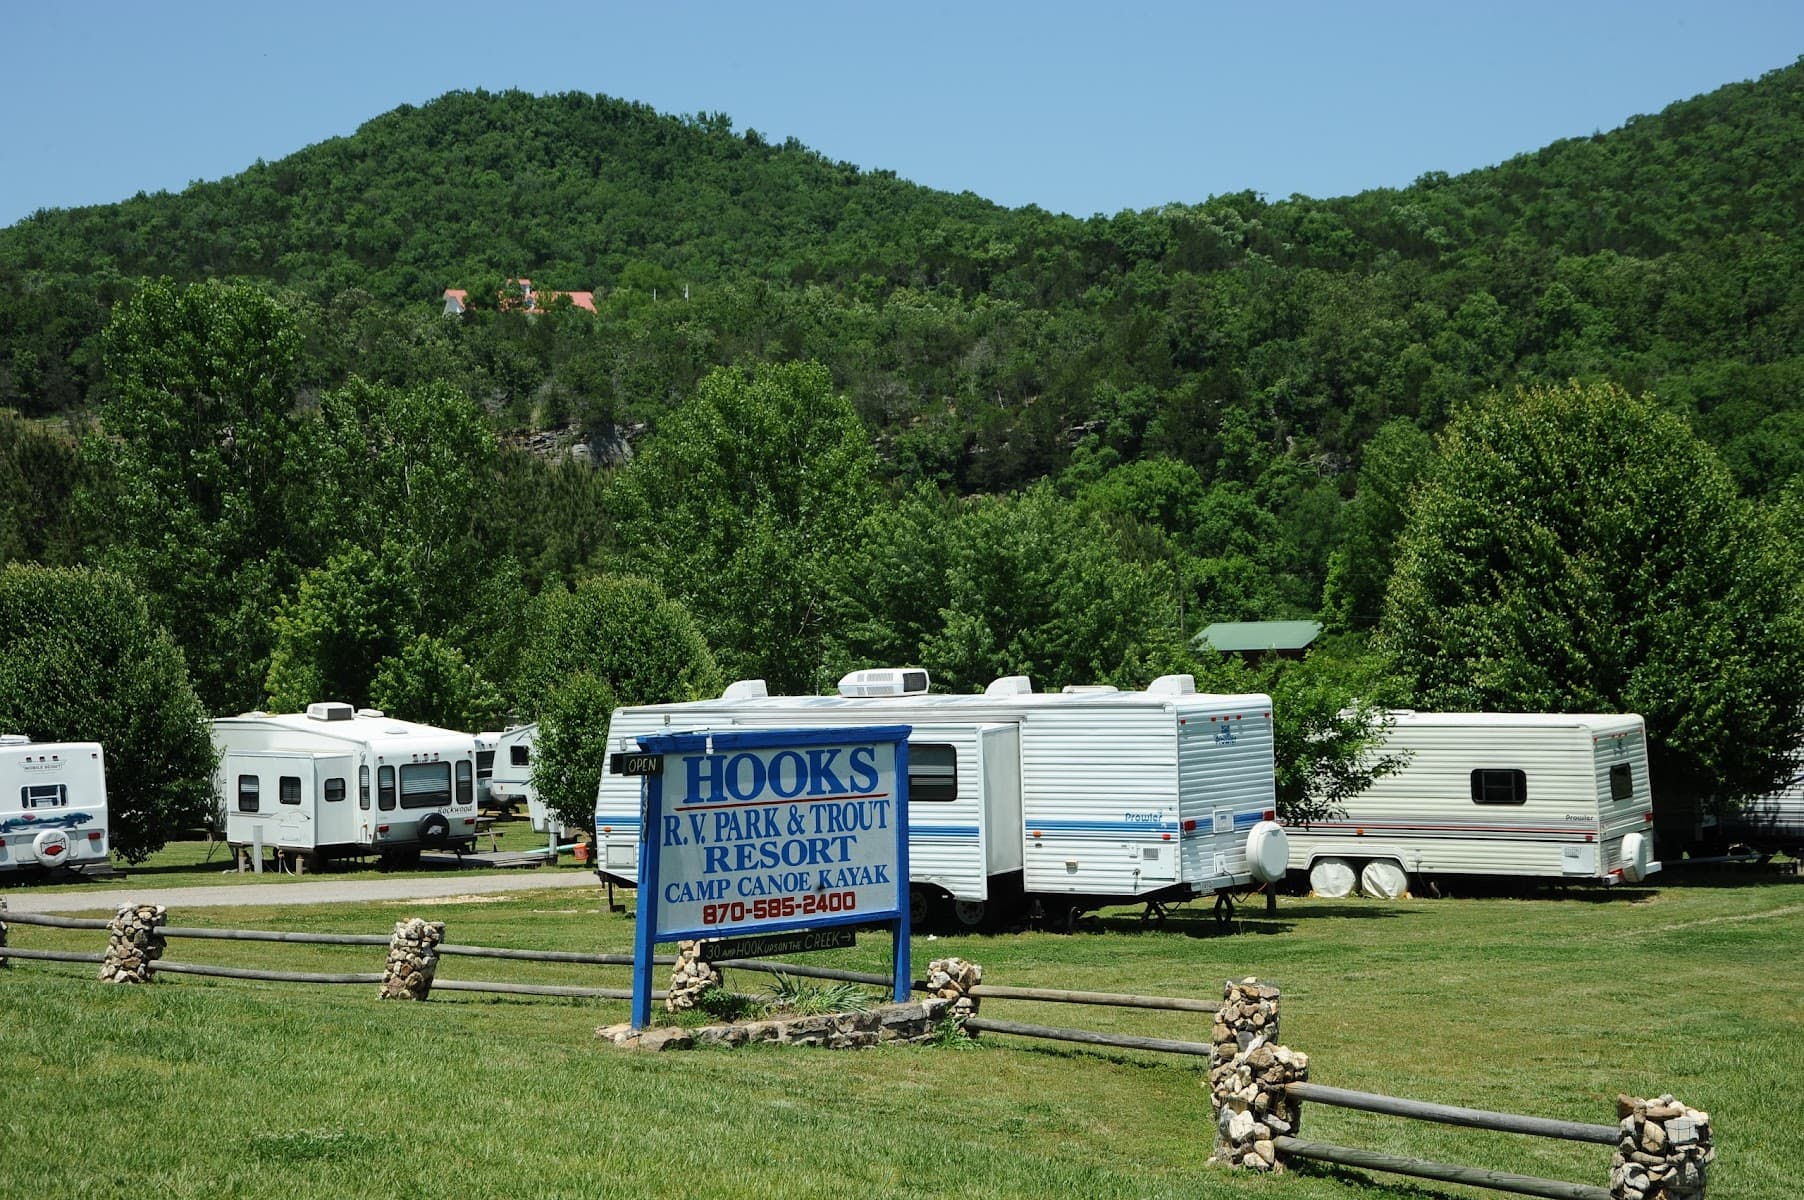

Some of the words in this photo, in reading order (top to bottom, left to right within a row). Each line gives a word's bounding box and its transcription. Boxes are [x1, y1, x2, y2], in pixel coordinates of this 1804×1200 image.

[628, 758, 657, 772] OPEN
[682, 747, 879, 804] HOOKS
[663, 812, 706, 847] R.V.
[714, 807, 782, 843] PARK
[786, 804, 806, 836] &
[810, 800, 890, 834] TROUT
[1125, 812, 1162, 822] Prowler
[703, 835, 857, 874] RESORT
[664, 879, 731, 903] CAMP
[737, 871, 812, 897] CANOE
[818, 864, 890, 889] KAYAK
[703, 891, 856, 925] 870-585-2400
[705, 944, 720, 959] 30
[804, 930, 841, 949] CREEK
